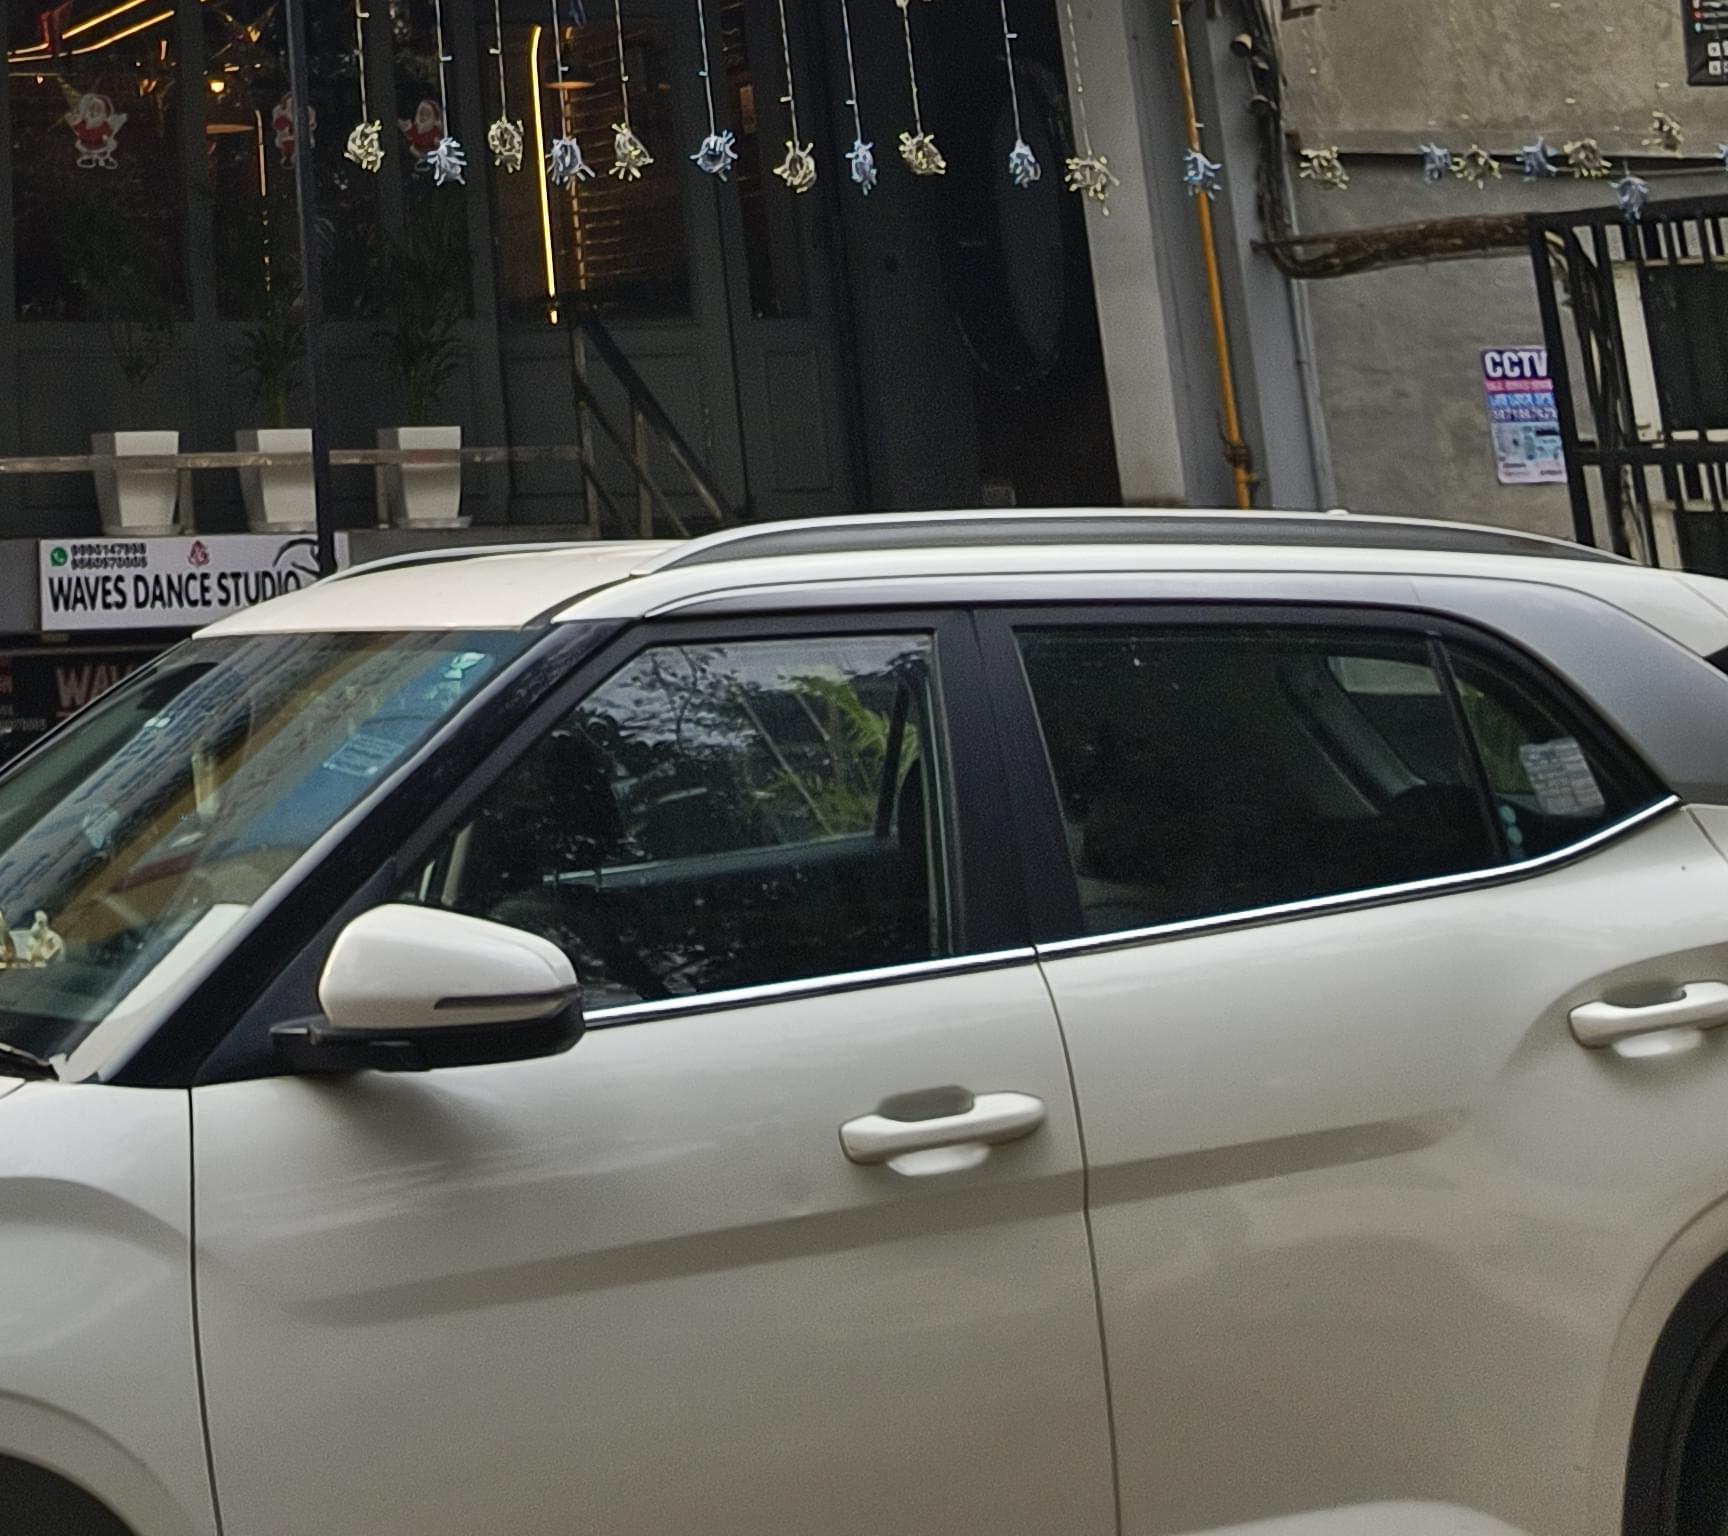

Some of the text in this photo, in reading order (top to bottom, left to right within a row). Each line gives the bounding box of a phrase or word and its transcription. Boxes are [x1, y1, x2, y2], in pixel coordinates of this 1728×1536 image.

[1485, 352, 1547, 378] CCTV
[49, 574, 126, 611] WAVES
[134, 572, 212, 609] DANCE
